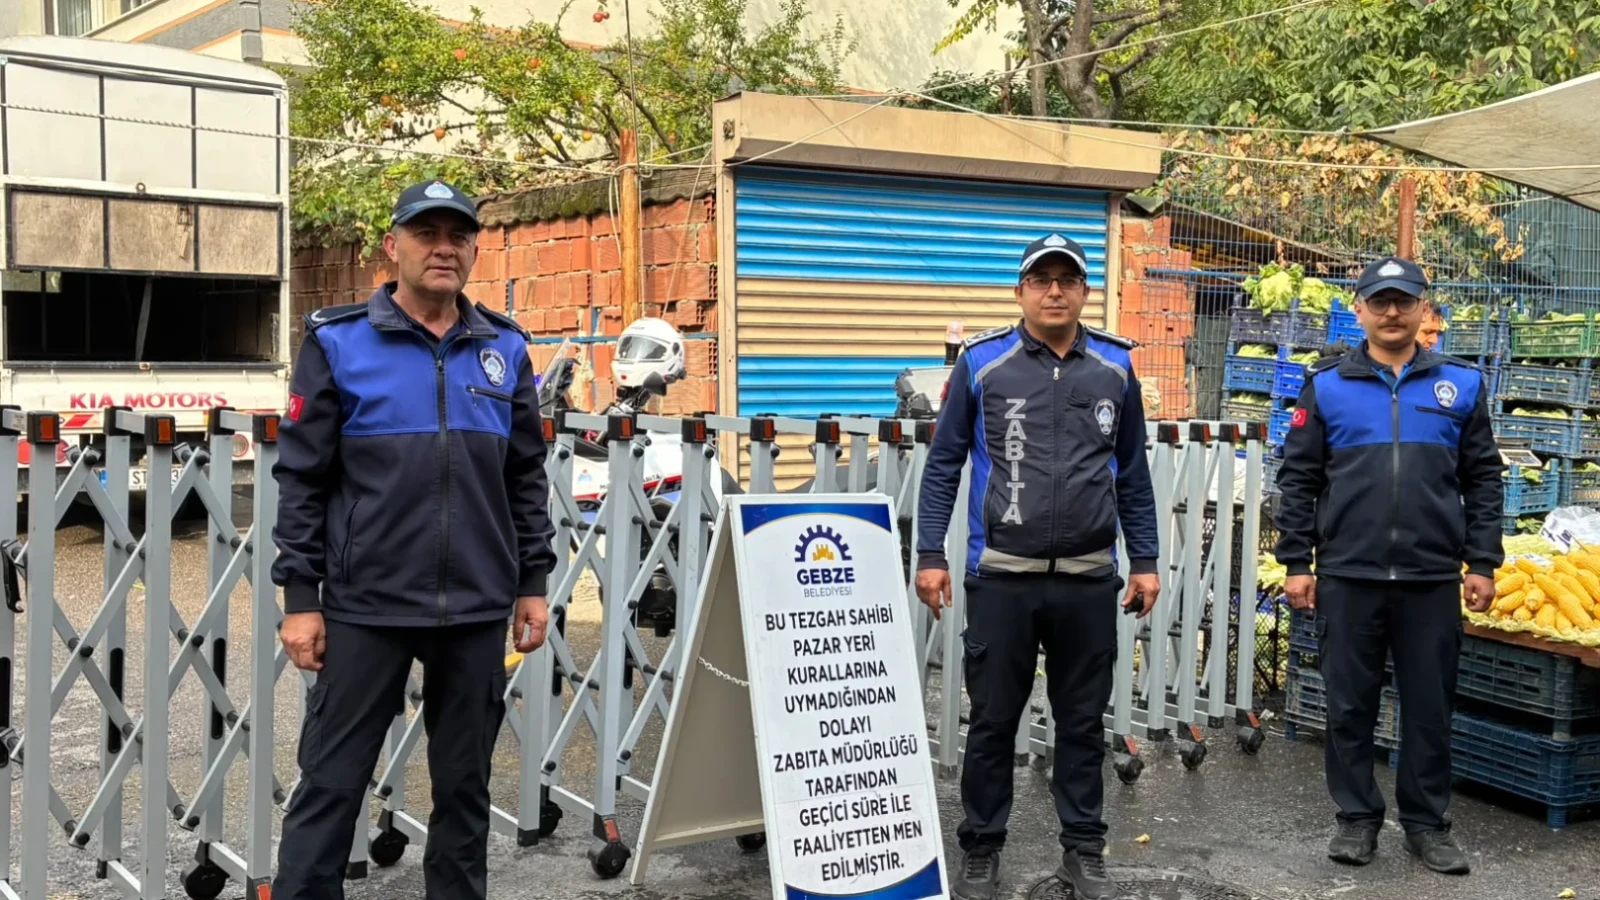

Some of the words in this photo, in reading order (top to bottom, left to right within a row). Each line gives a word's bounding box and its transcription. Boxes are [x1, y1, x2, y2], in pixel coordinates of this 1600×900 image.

[70, 392, 115, 409] KIA
[124, 391, 228, 409] MOTORS
[1001, 398, 1027, 525] ZABITA
[796, 567, 856, 585] GEBZE
[803, 586, 853, 598] BELEDİYESİ
[765, 613, 786, 631] BU
[789, 610, 846, 630] TEZGAH
[850, 603, 894, 625] SAHİBİ
[793, 637, 841, 657] PAZAR
[844, 631, 876, 652] YERİ
[787, 660, 888, 685] KURALLARINA
[784, 686, 897, 713] UYMADIĞINDAN
[819, 715, 872, 738] DOLAYI
[773, 750, 829, 773] ZABITA
[832, 734, 918, 765] MÜDÜRLÜĞÜ
[805, 768, 898, 797] TARAFINDAN
[799, 802, 849, 827] GEÇİCİ
[851, 796, 888, 819] SÜRE
[892, 793, 912, 813] İLE
[793, 825, 891, 857] FAALİYETTEN
[893, 820, 923, 841] MEN
[821, 849, 905, 881] EDİLMİŞTİR.
